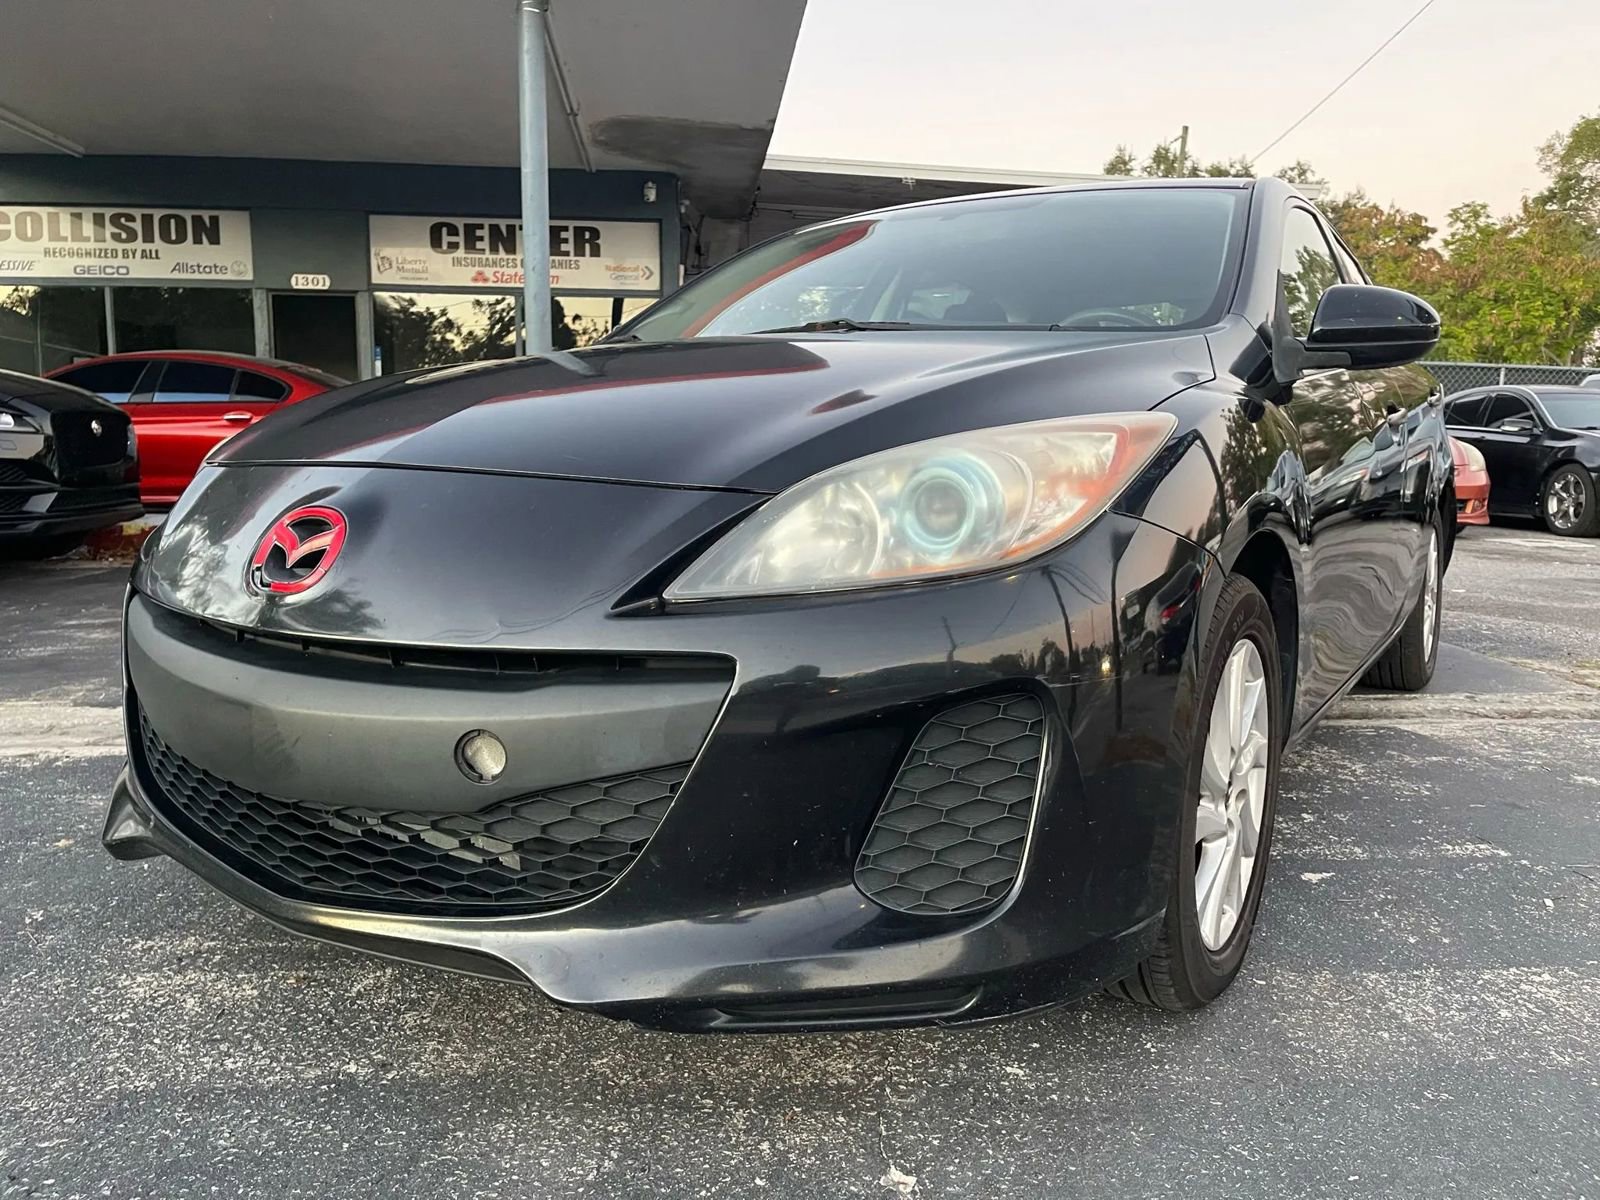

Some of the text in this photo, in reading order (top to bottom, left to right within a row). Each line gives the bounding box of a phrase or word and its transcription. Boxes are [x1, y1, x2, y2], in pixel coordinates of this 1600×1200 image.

[429, 221, 601, 258] CENER
[43, 247, 161, 260] RECOGNIZED BY ALL
[170, 262, 228, 275] Allstate
[452, 256, 518, 270] INSURANCES
[73, 265, 130, 276] GEICO
[294, 275, 326, 288] 1301
